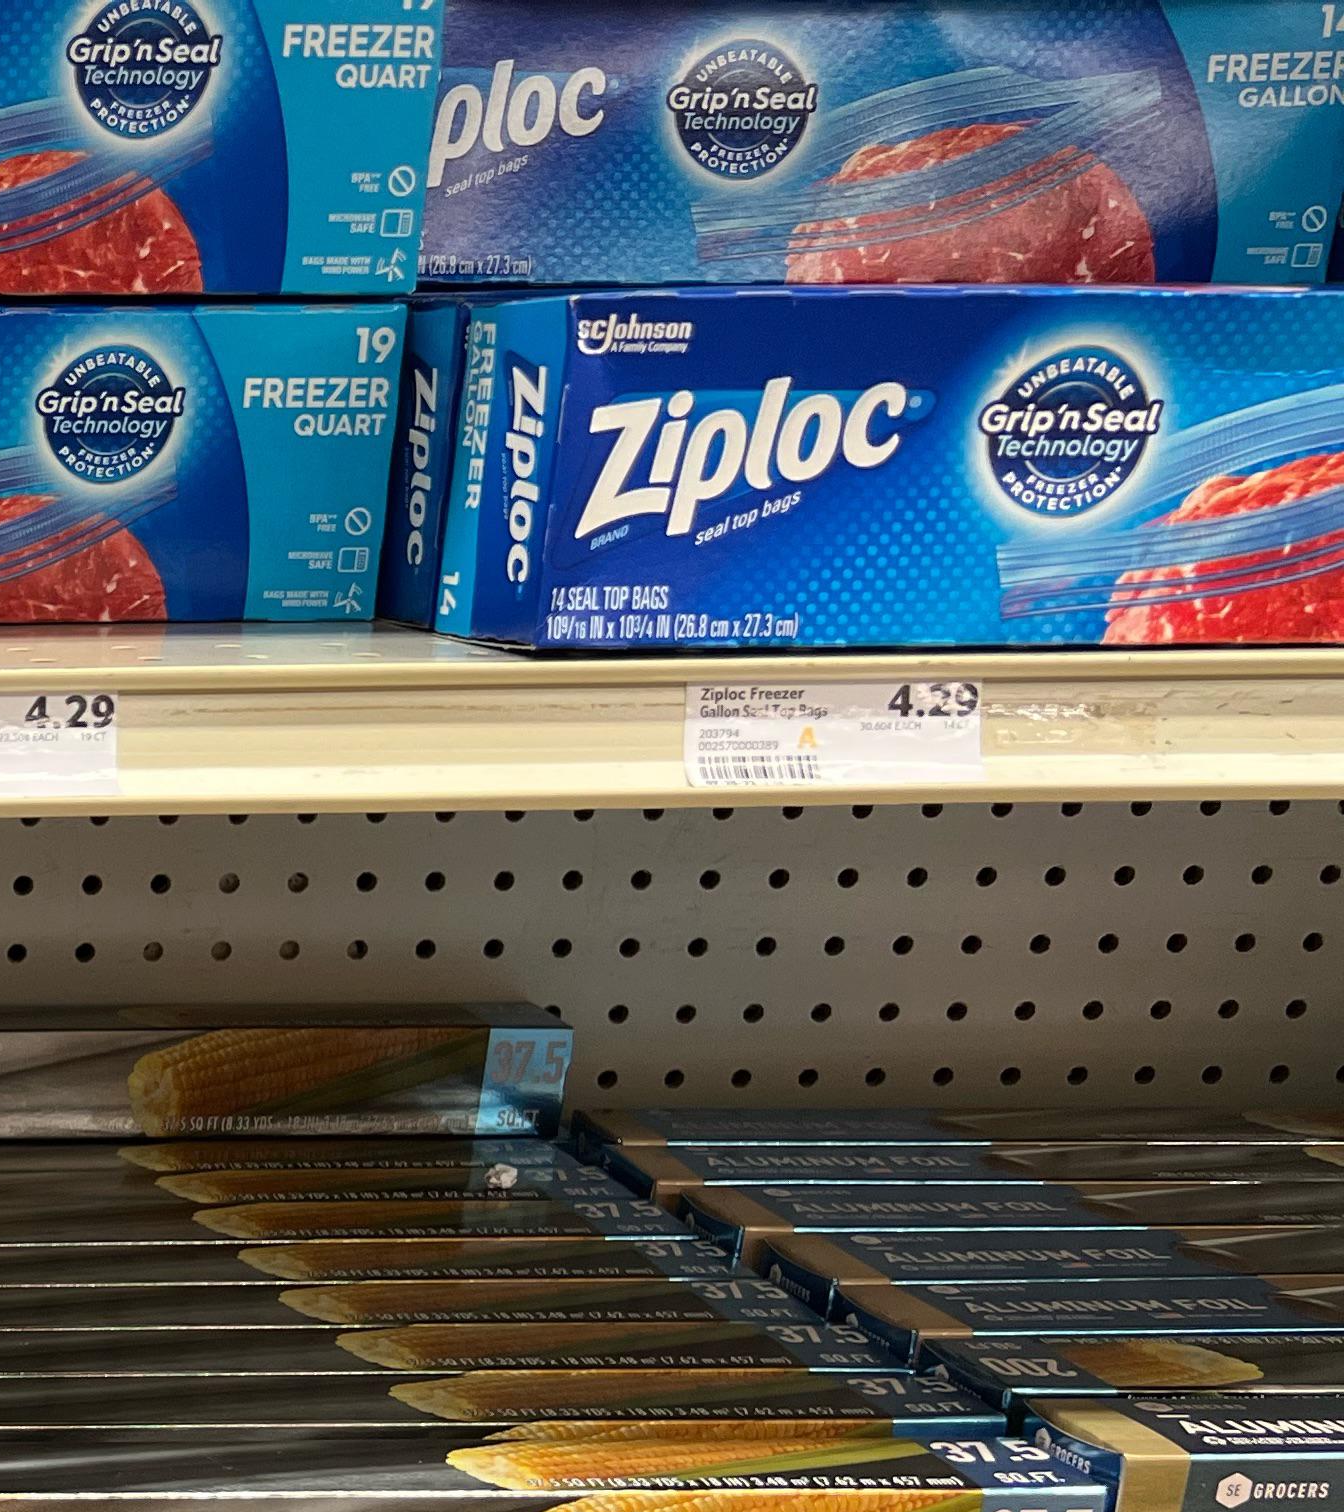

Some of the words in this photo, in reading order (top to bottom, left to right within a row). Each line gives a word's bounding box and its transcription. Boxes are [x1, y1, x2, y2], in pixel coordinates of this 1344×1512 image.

[282, 24, 435, 58] FREEZER
[335, 63, 432, 89] QUART
[752, 85, 817, 110] Seal
[683, 111, 800, 135] Technology
[356, 326, 396, 365] 19
[242, 376, 390, 410] FREEZER
[1016, 356, 1136, 401] UNBEATABLE
[293, 414, 387, 437] QUART
[1082, 402, 1161, 433] Seal
[574, 375, 907, 539] Ziploc
[996, 434, 1140, 462] Technology
[506, 365, 549, 584] Ziploc
[694, 517, 730, 546] seal
[732, 508, 758, 531] top
[761, 490, 802, 519] bags
[551, 587, 566, 611] 14
[567, 586, 601, 611] SEAL
[603, 586, 629, 610] TOP
[632, 586, 670, 610] BAGS
[25, 694, 115, 729] 4.29
[887, 683, 979, 718] 4.29
[1253, 1482, 1330, 1499] GROCERS
